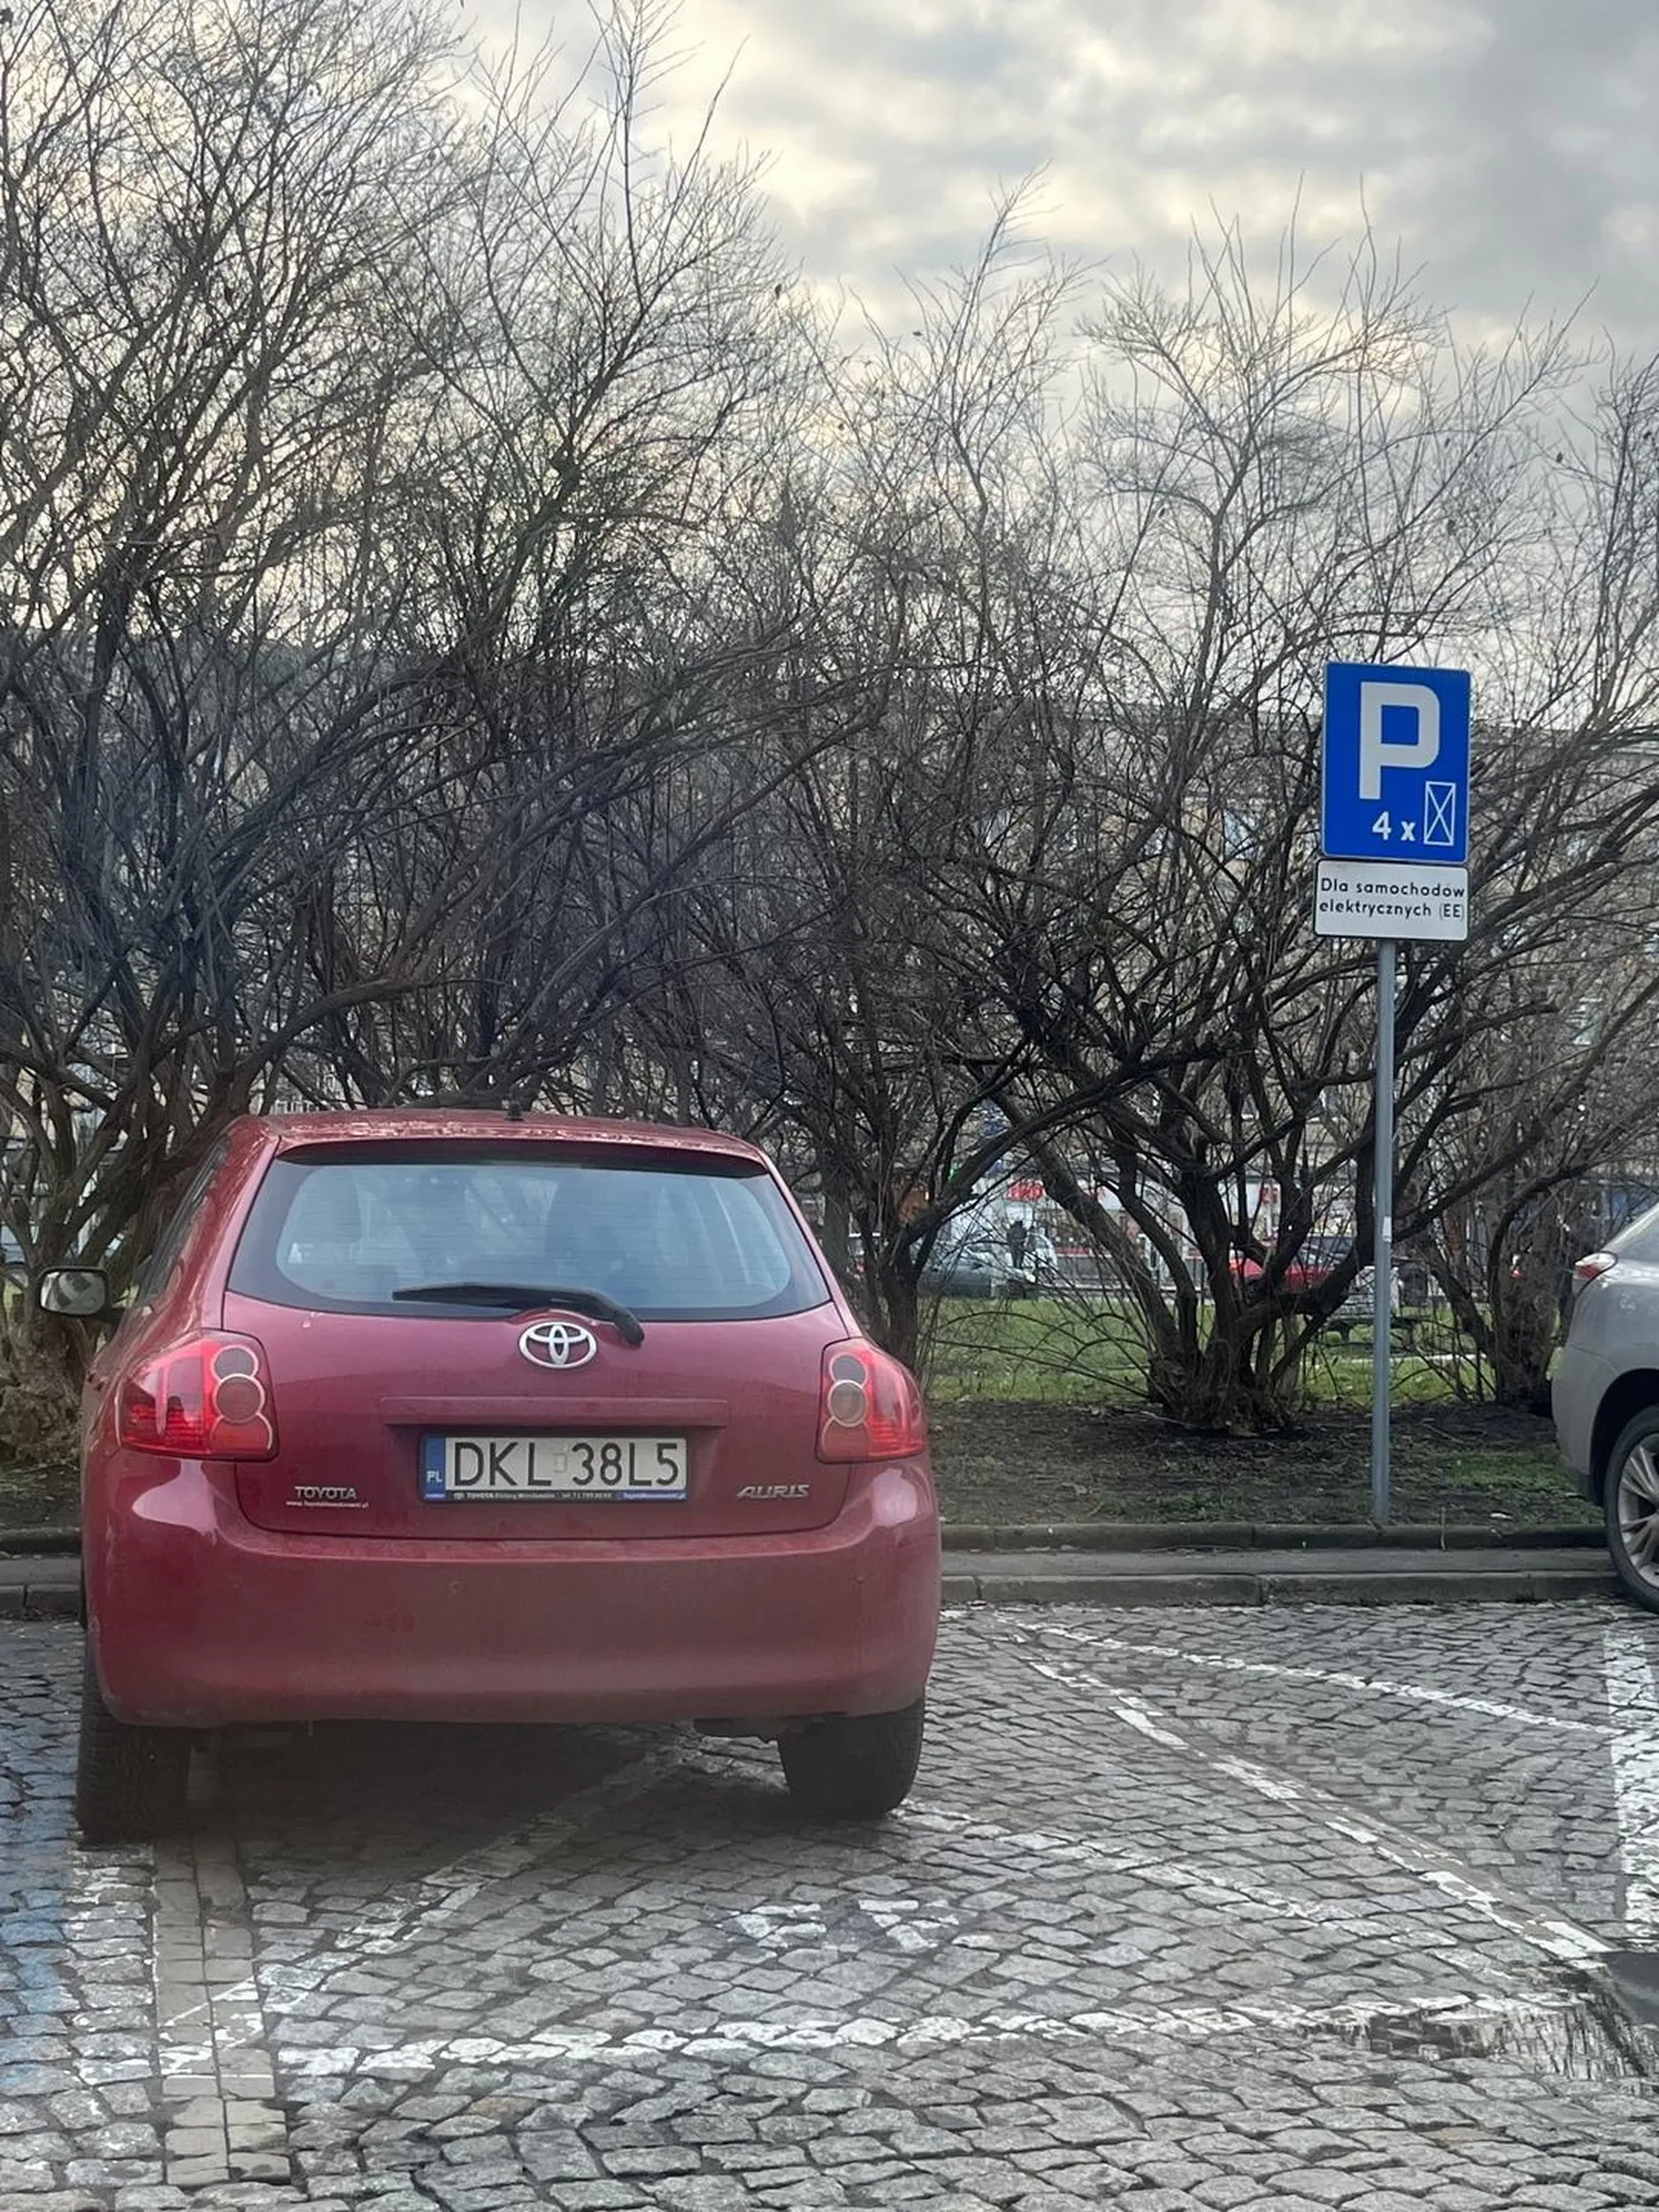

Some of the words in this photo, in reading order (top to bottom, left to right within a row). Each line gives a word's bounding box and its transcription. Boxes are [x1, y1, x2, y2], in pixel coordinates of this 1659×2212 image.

[1359, 681, 1440, 800] P
[1321, 878, 1348, 892] Dla
[1319, 898, 1432, 918] elektrycznych
[1439, 902, 1465, 921] (EE)
[454, 1441, 552, 1486] DKL
[572, 1442, 680, 1486] 38L5
[426, 1471, 443, 1483] PL
[295, 1486, 357, 1500] TOYOTA
[736, 1484, 810, 1499] AURIS
